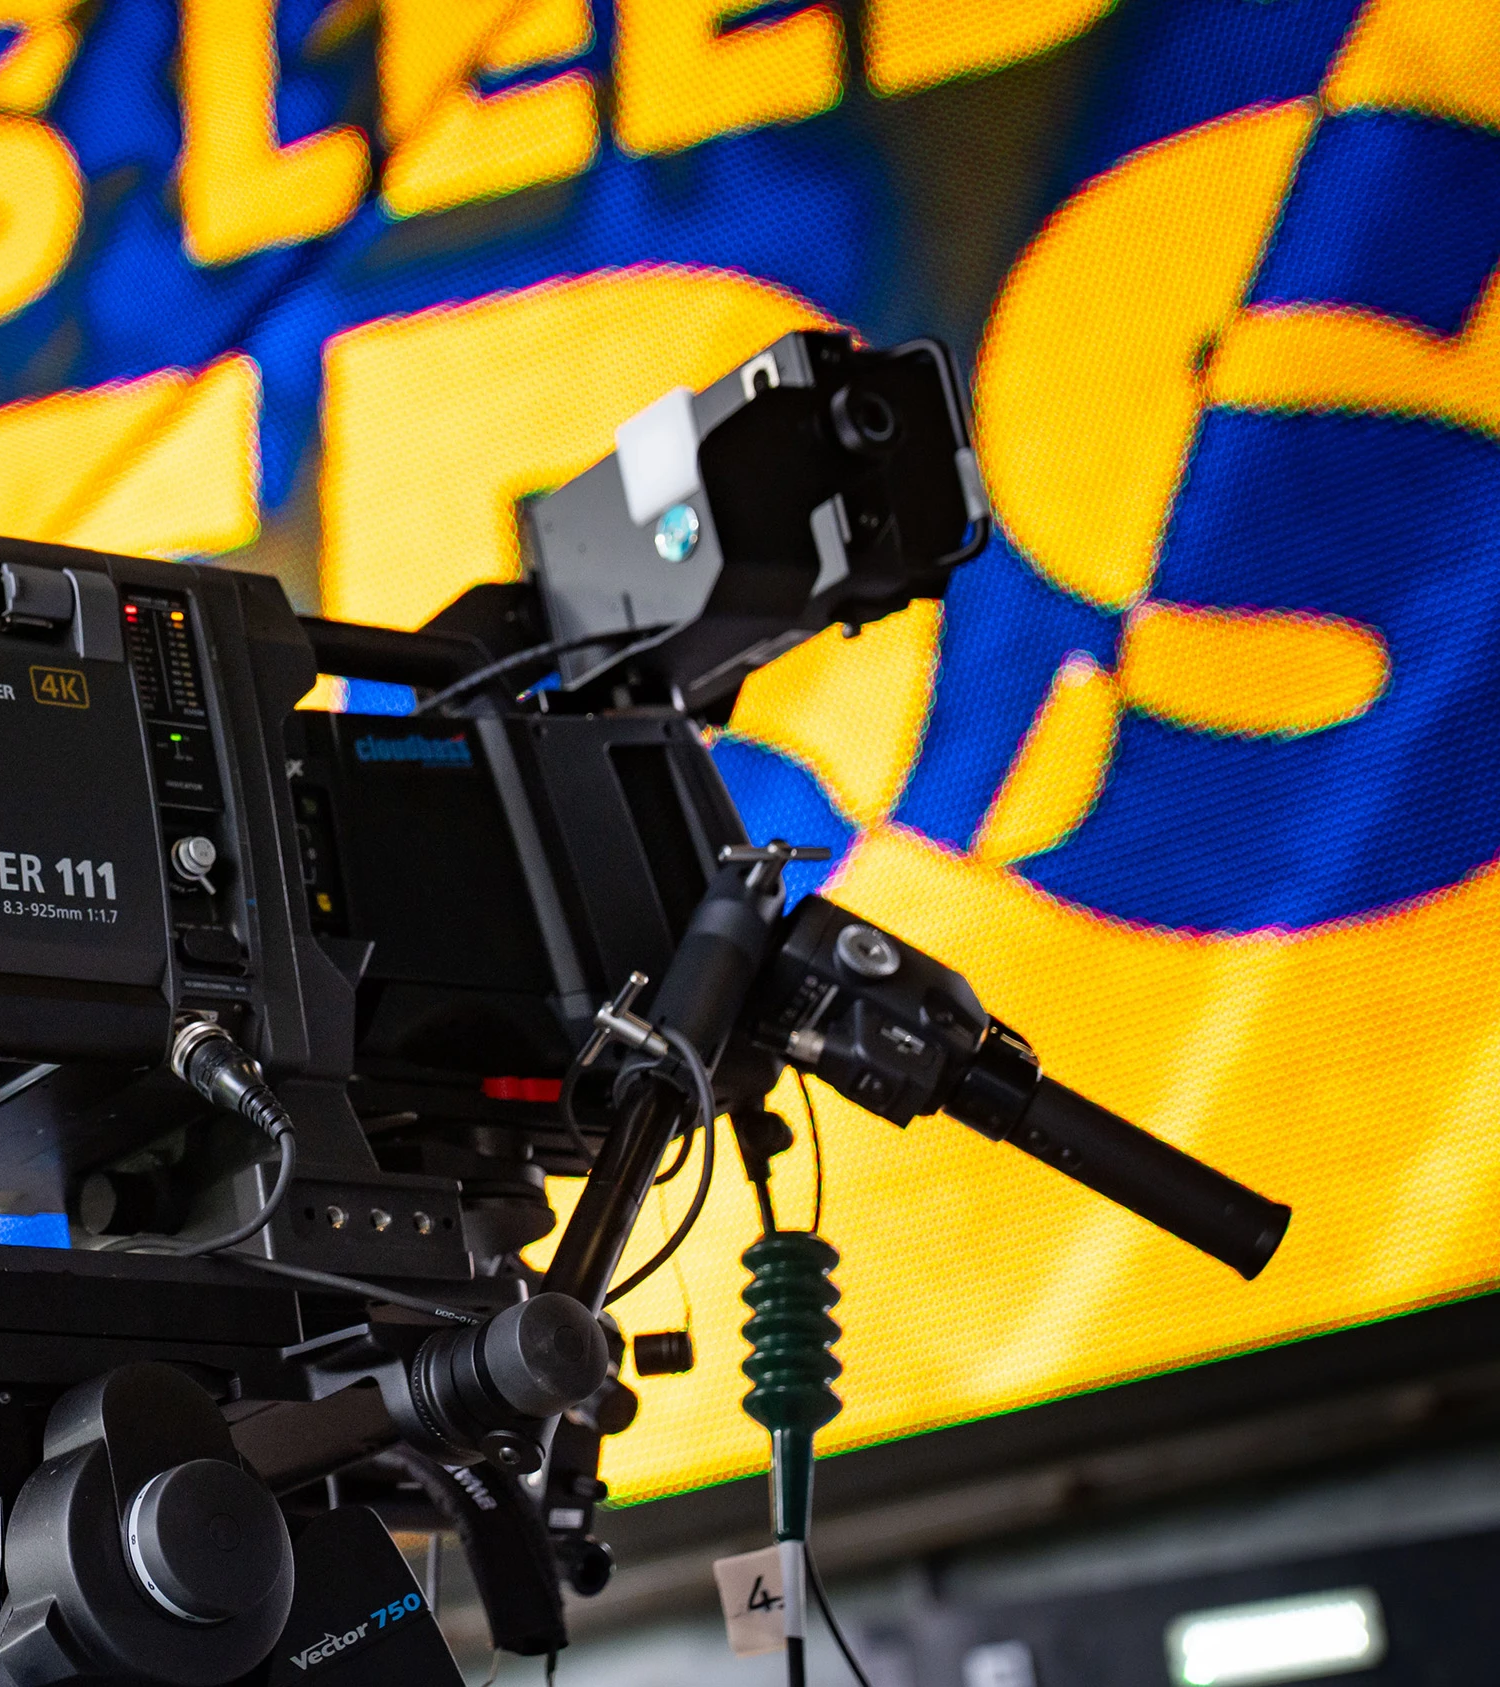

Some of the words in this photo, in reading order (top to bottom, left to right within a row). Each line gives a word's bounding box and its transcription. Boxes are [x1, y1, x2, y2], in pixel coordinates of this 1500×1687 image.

[39, 673, 80, 702] 4K
[54, 857, 117, 900] 111
[2, 899, 83, 922] 8.3-925mm
[86, 907, 119, 925] 1:1.7
[289, 1621, 369, 1671] Vector
[369, 1592, 422, 1630] 750
